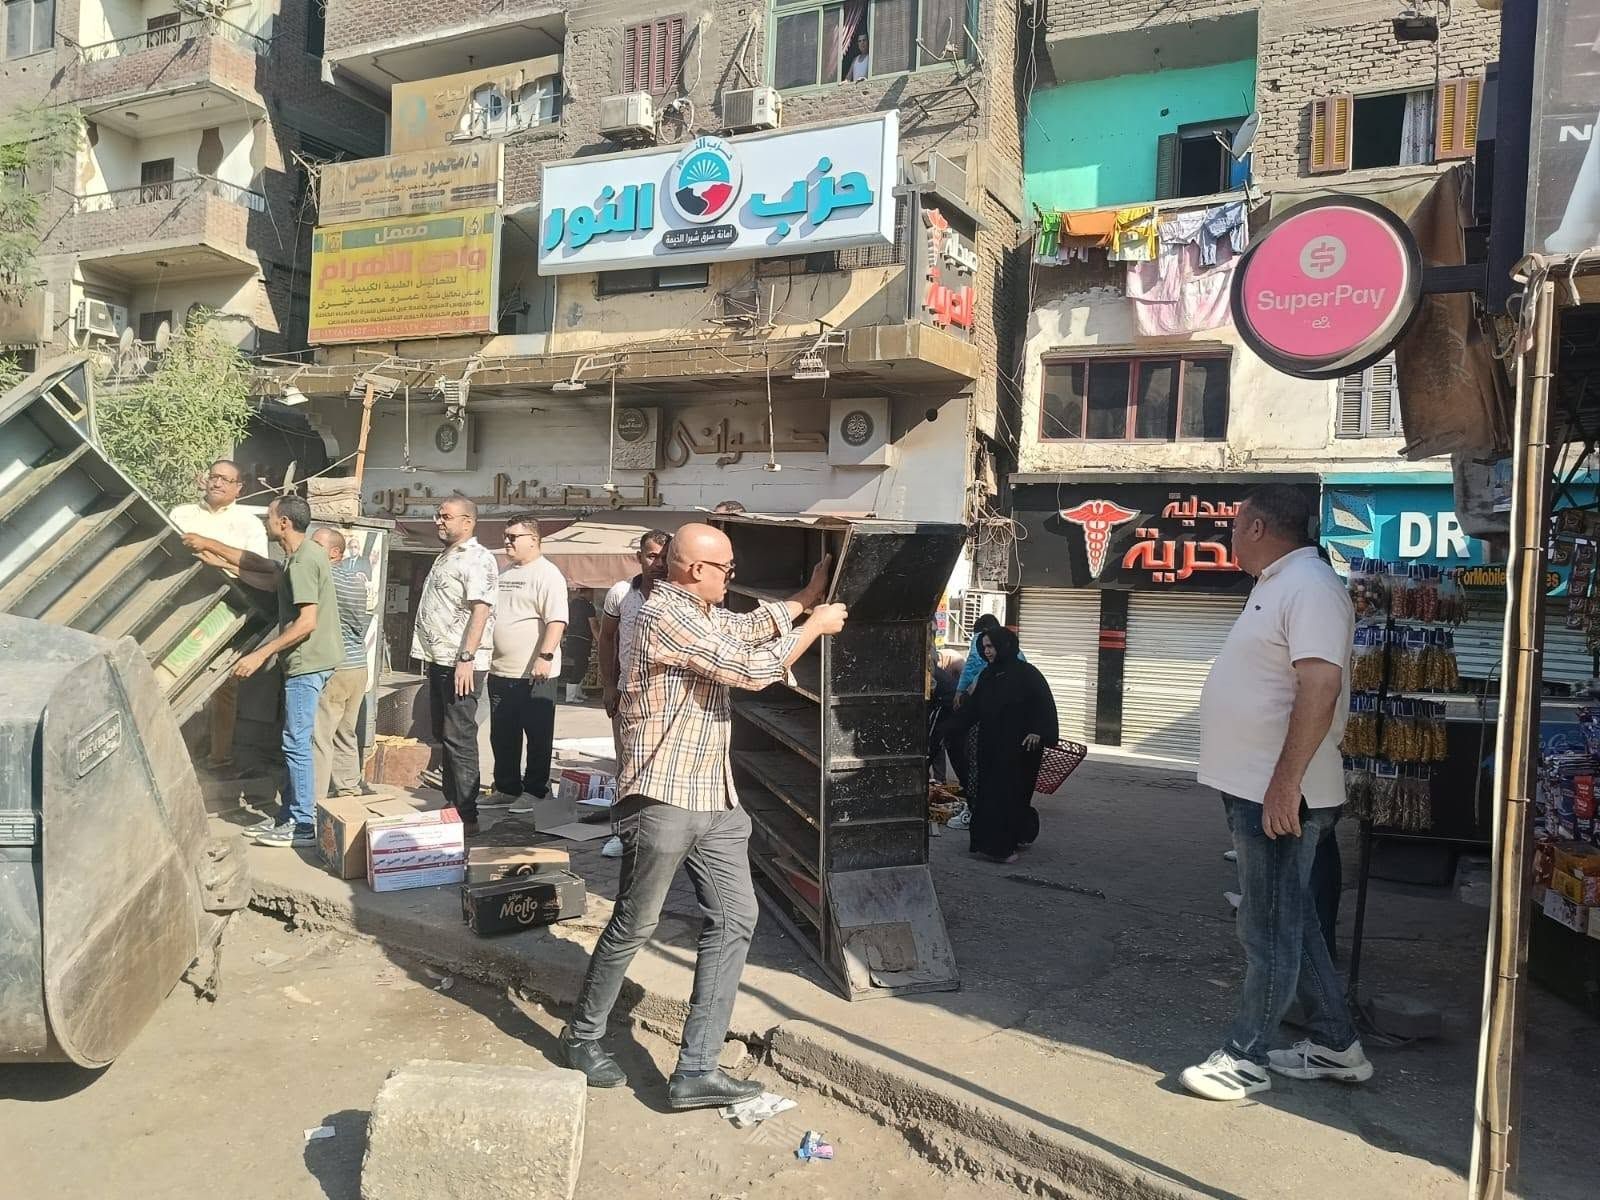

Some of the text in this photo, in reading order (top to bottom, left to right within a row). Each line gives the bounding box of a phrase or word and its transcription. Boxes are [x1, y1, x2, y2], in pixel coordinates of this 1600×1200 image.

[543, 156, 874, 250] حزب النور
[374, 225, 429, 245] معمل
[665, 226, 733, 246] أمانة شرق شبرا الخيمة
[383, 280, 413, 292] الطبية
[415, 275, 457, 289] للتحاليل
[358, 297, 385, 305] محمد
[389, 294, 419, 304] عمرو
[1257, 284, 1386, 313] SuperPay
[499, 896, 538, 920] Molto
